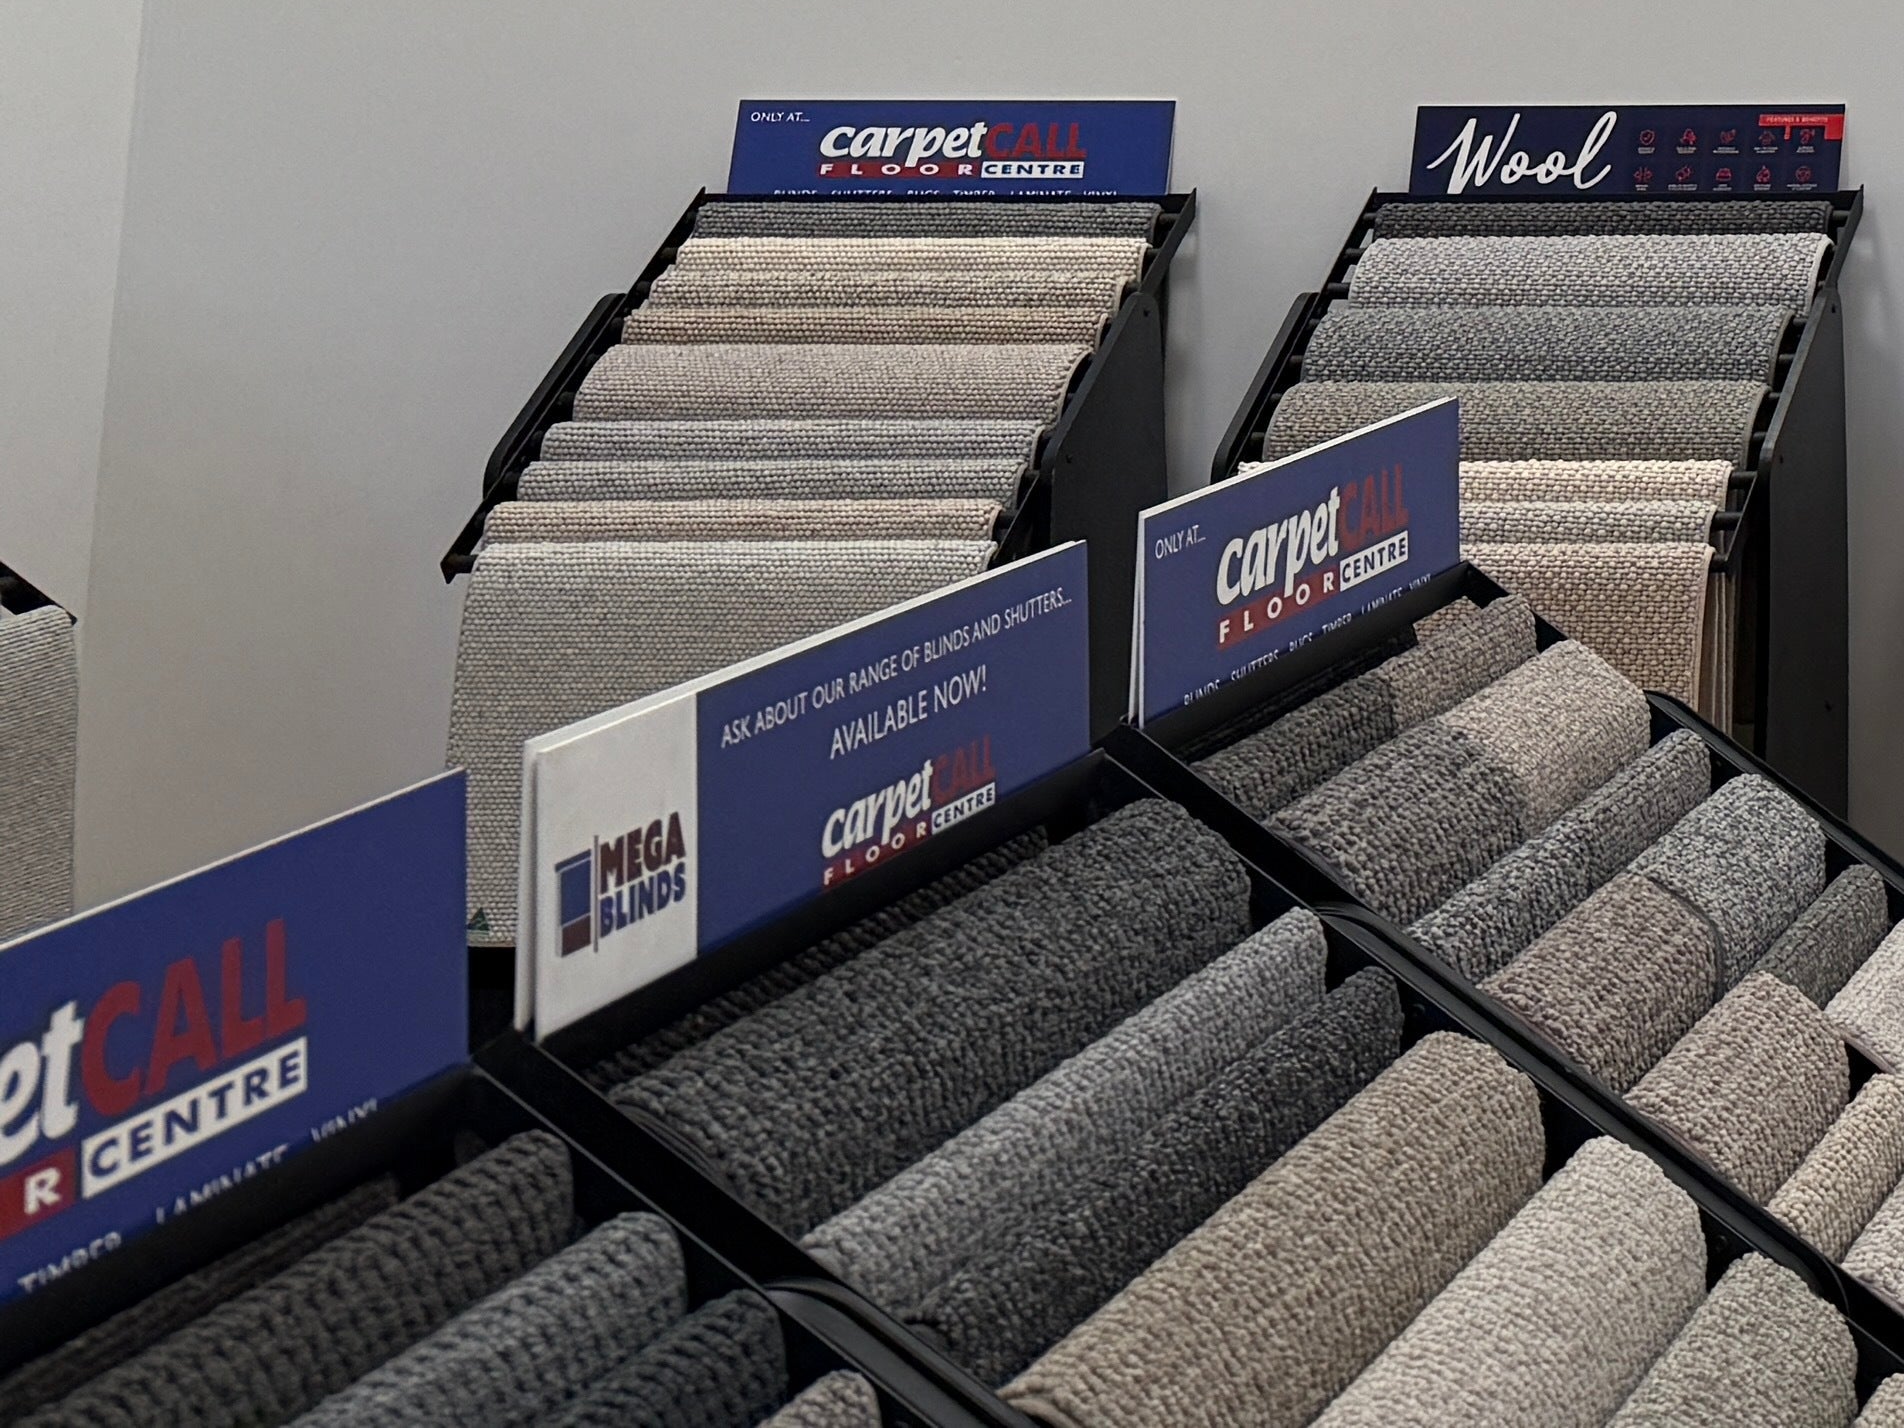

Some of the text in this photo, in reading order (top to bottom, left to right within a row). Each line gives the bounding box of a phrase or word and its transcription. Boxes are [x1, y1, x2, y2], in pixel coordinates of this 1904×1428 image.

[750, 111, 784, 123] ONLY
[1426, 110, 1618, 194] Wool
[820, 162, 1081, 176] FLOOR CENTRE
[1154, 530, 1185, 560] ONLY
[1218, 535, 1408, 644] FLOOR CENTRE
[720, 714, 751, 748] ASK
[754, 691, 808, 736] ABOUT
[811, 677, 846, 710] OUR
[849, 654, 898, 695] RANGE
[901, 646, 921, 672] OF
[924, 625, 971, 663] BLINDS
[971, 613, 1002, 644] AND
[829, 664, 988, 760] AVAILABLE NOW!
[599, 811, 687, 896] MEGA
[823, 785, 994, 887] FLOOR CENTRE
[599, 861, 686, 940] BLINDS
[0, 918, 308, 1166] etCALL
[88, 1049, 303, 1179] CENTRE
